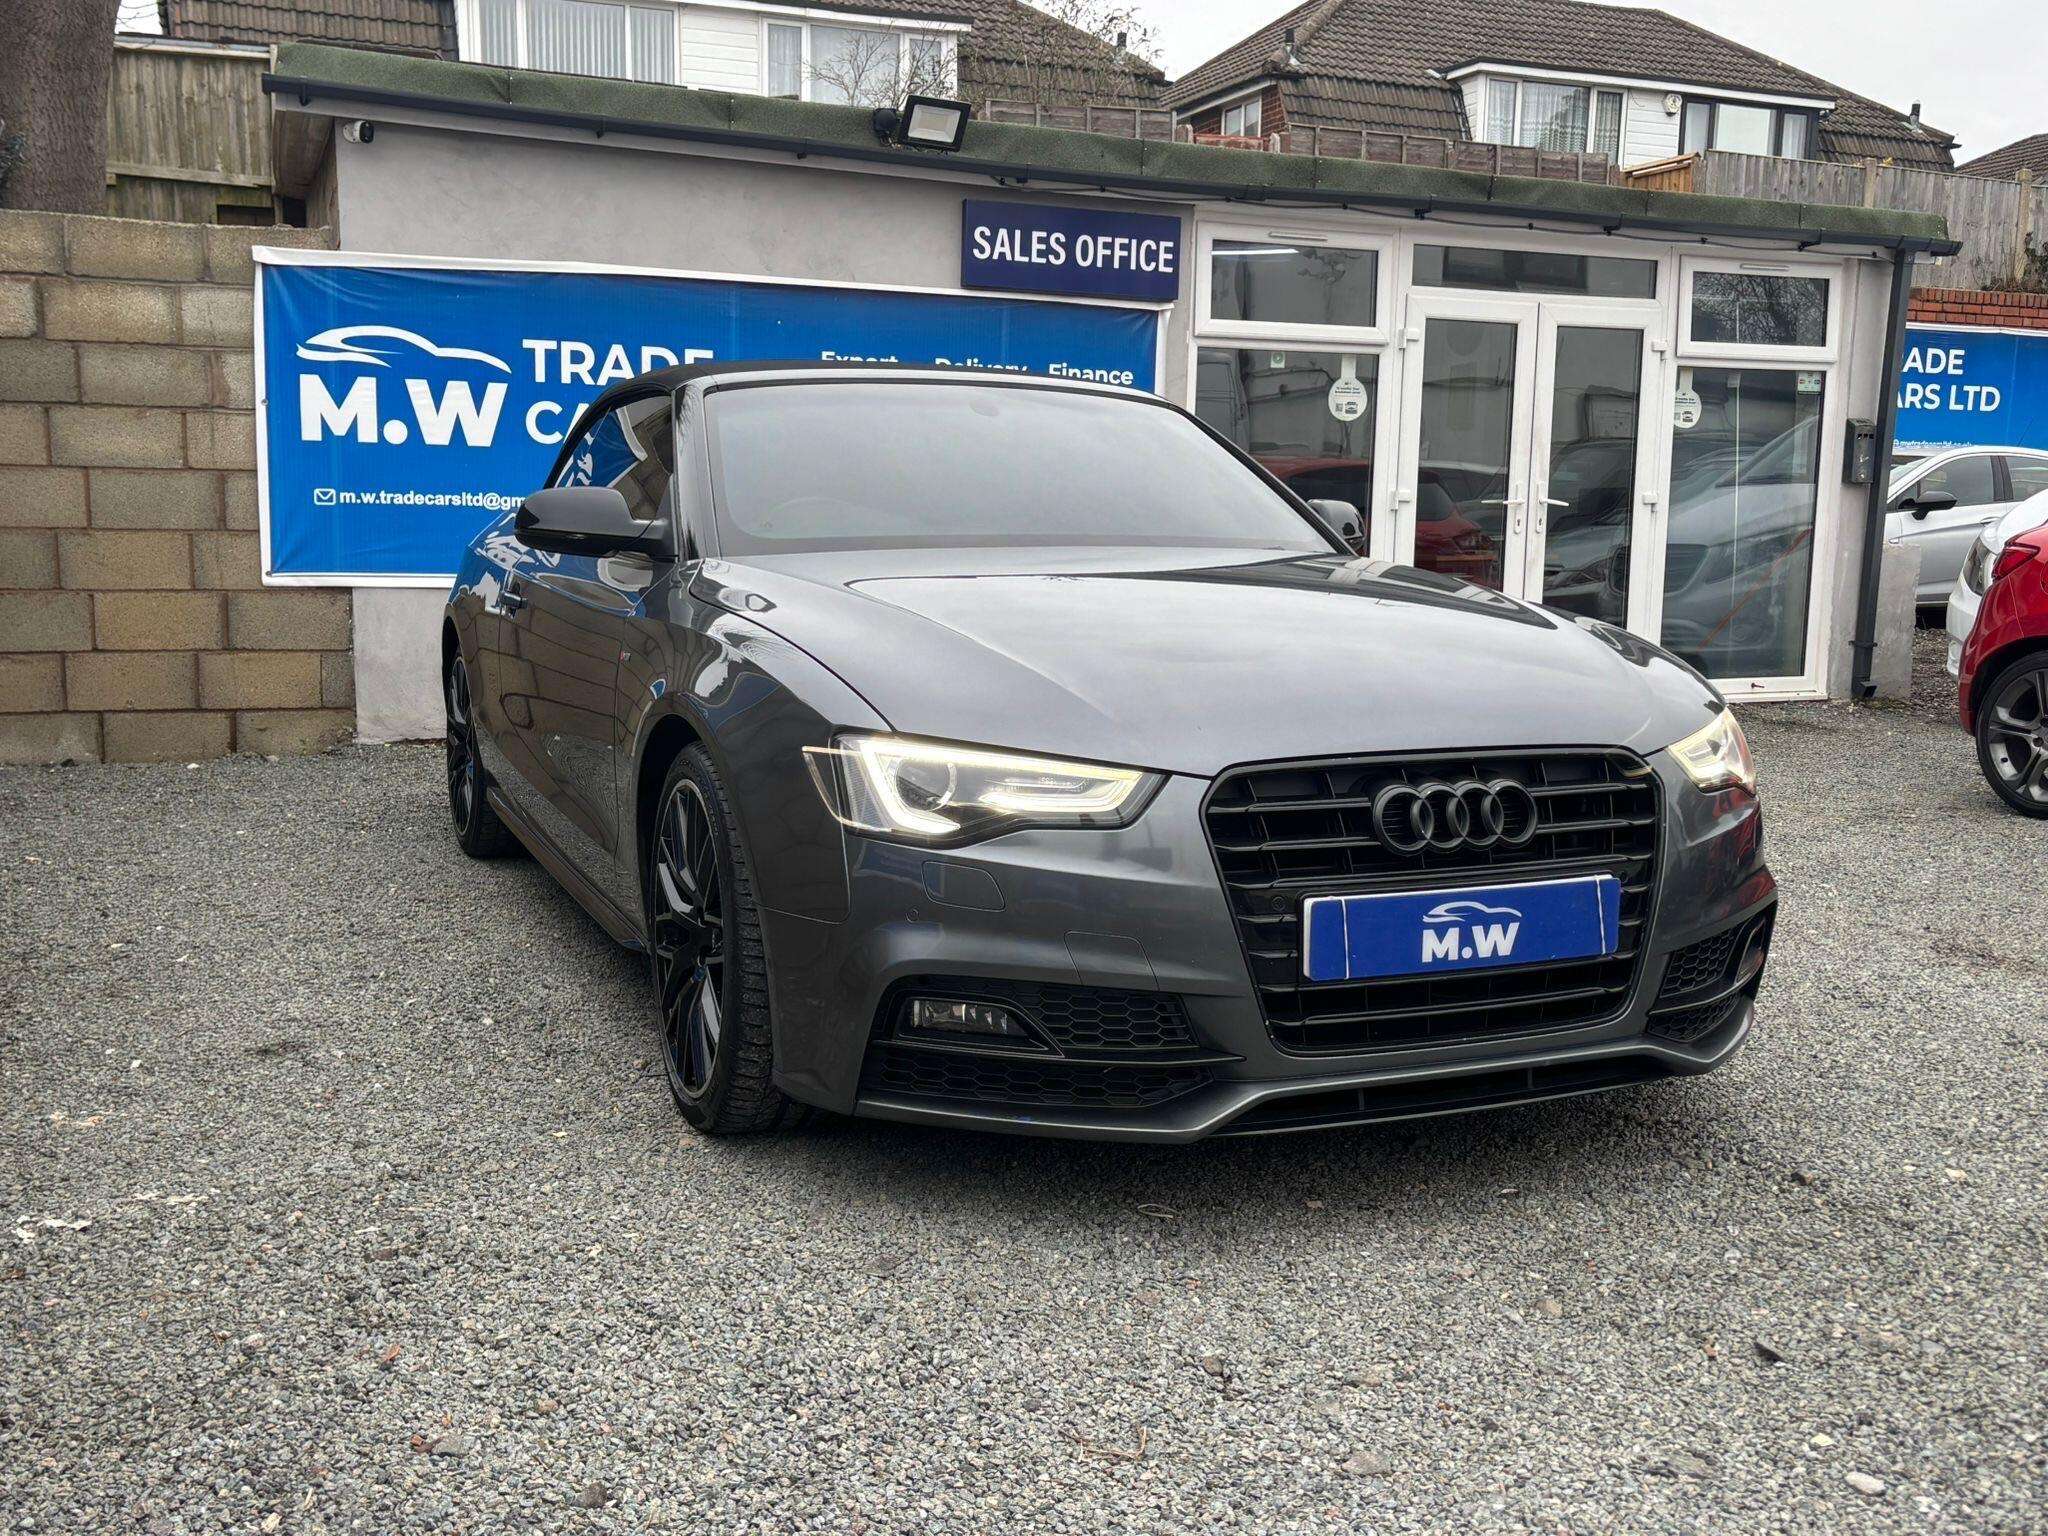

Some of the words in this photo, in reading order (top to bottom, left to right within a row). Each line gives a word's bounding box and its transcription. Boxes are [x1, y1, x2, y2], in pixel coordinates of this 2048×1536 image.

[972, 226, 1067, 265] SALES
[1076, 235, 1175, 274] OFFICE
[1901, 347, 1966, 375] ADE
[299, 373, 508, 448] M.W
[1949, 384, 2001, 412] LTD
[1421, 922, 1520, 964] M.W
